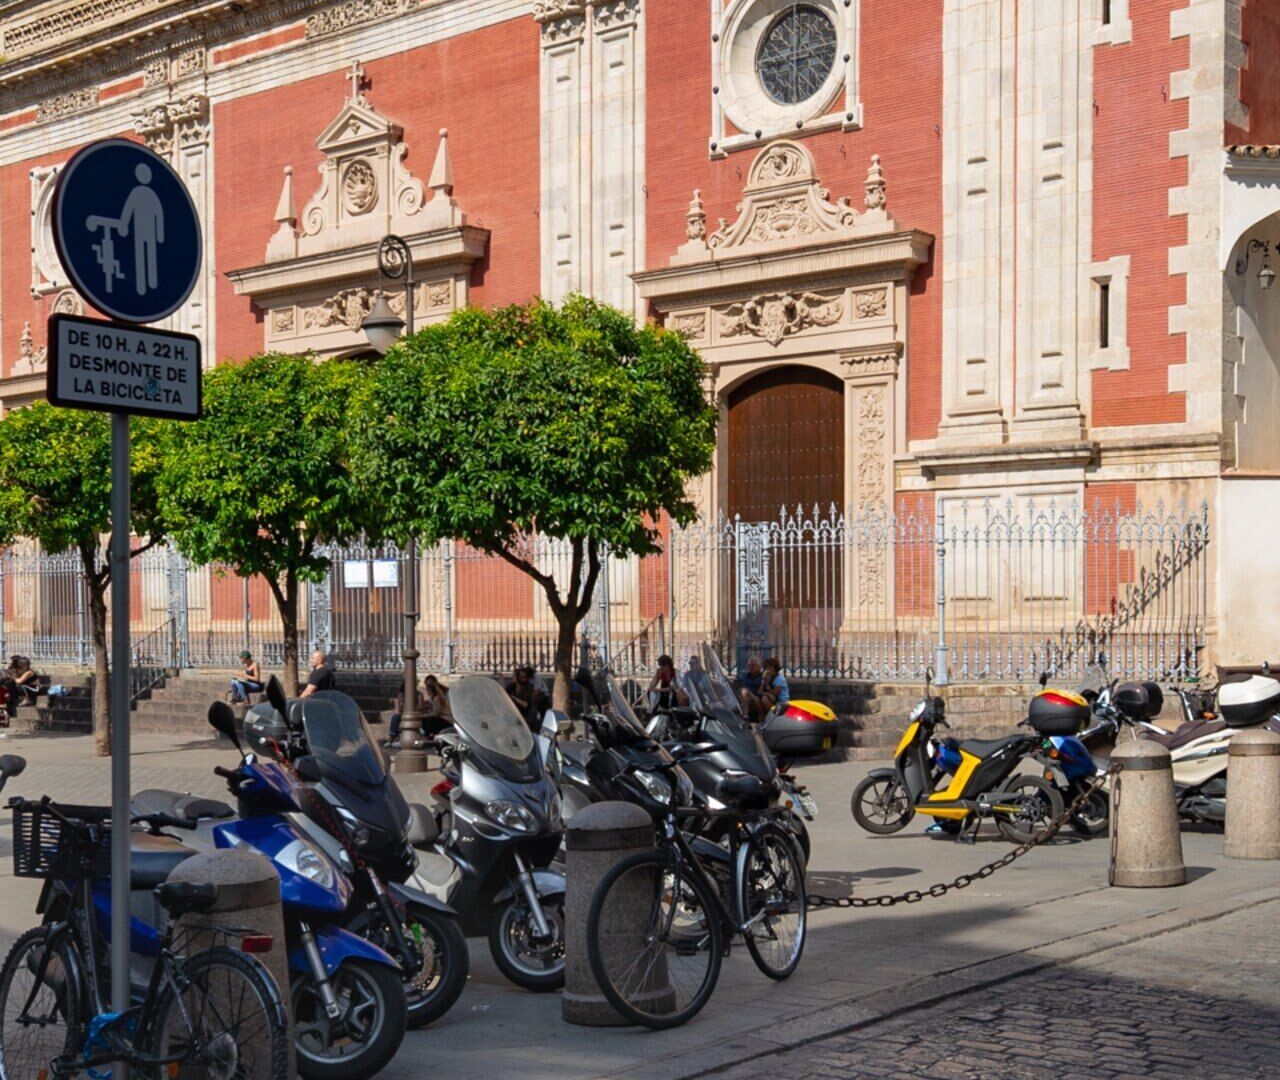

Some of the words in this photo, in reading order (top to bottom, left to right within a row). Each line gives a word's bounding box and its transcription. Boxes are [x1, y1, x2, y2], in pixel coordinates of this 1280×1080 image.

[68, 329, 90, 347] DE
[95, 334, 113, 350] 10
[116, 337, 131, 353] H.
[136, 341, 147, 356] A
[153, 342, 171, 359] 22
[174, 345, 189, 361] H.
[69, 353, 162, 380] DESMONTE
[167, 367, 187, 383] DE
[74, 377, 95, 395] LA
